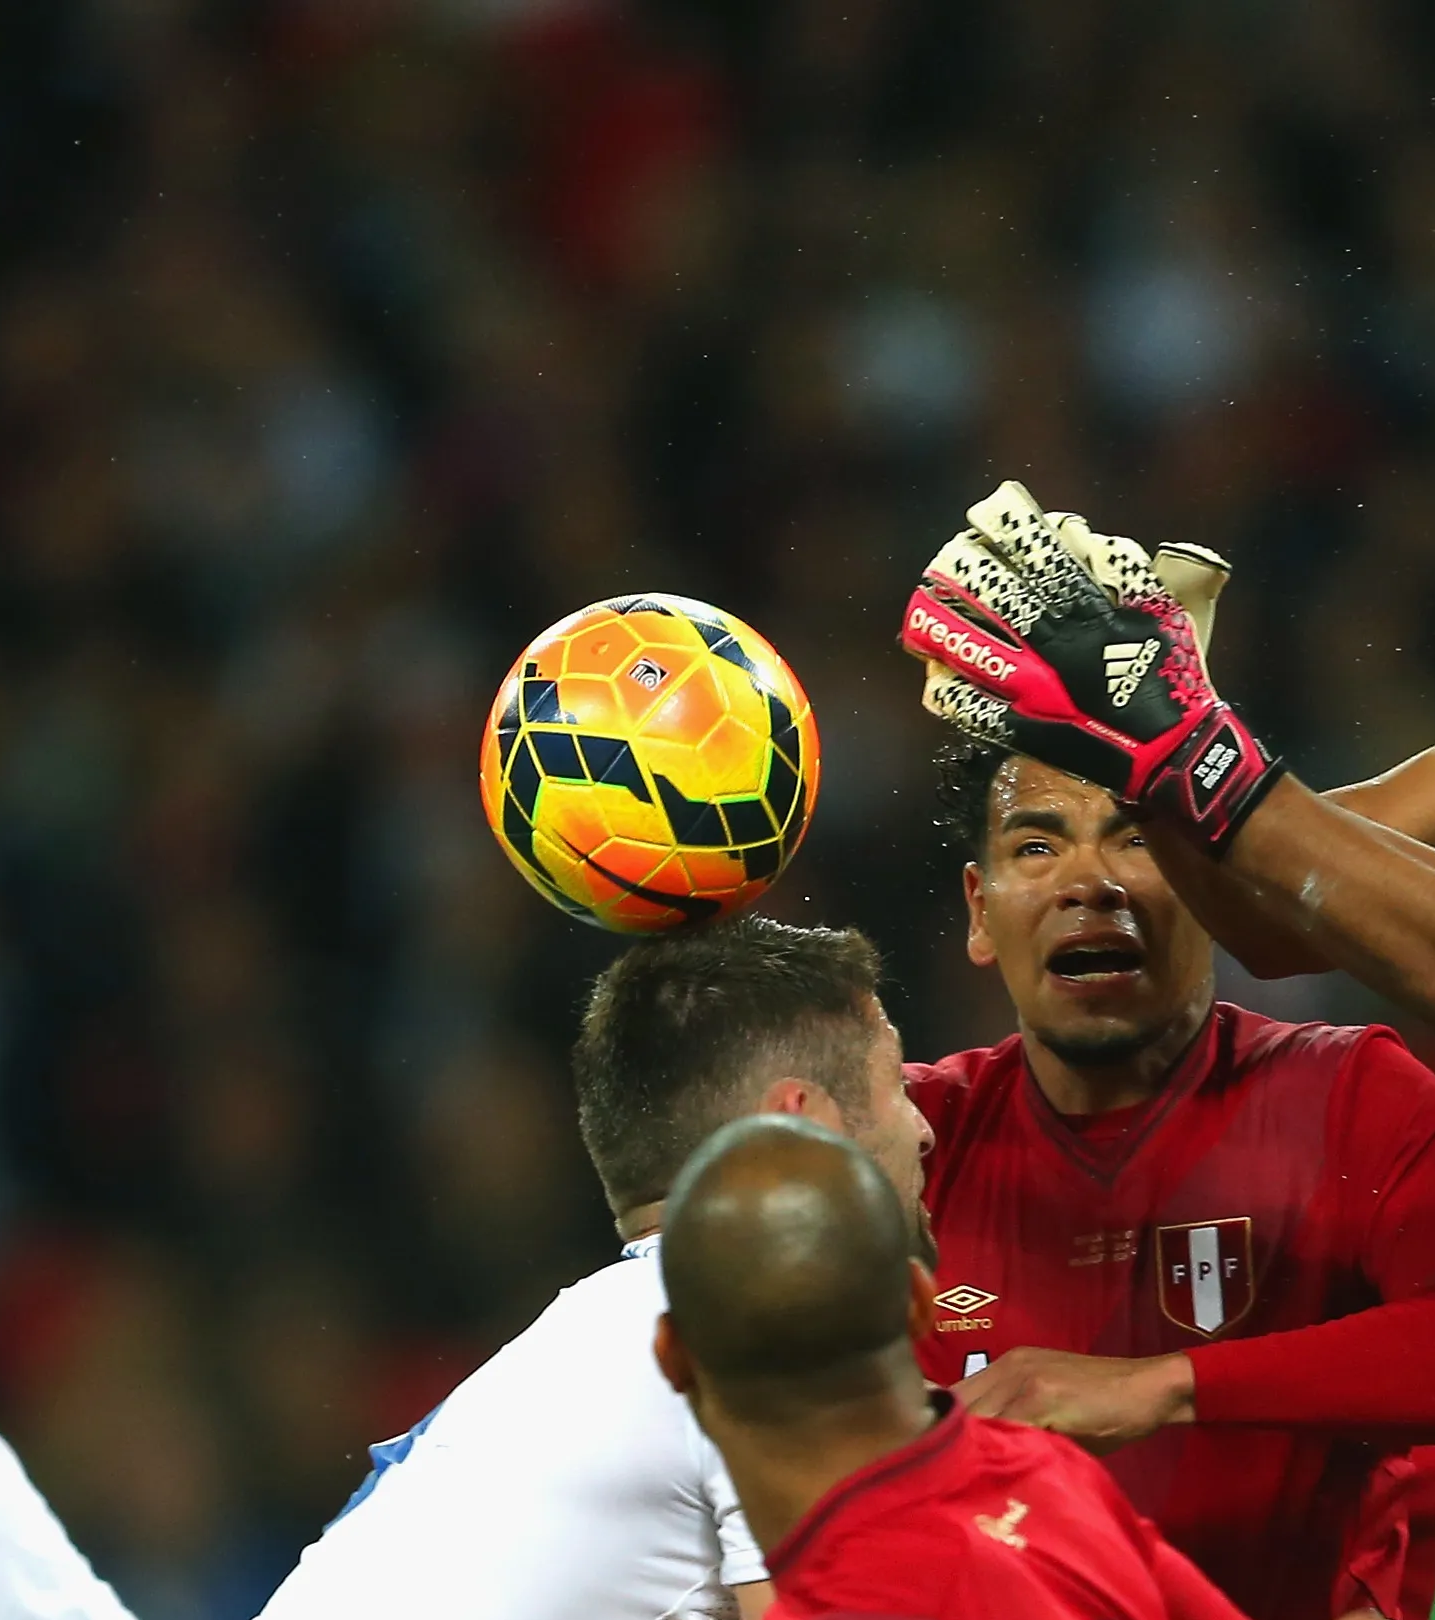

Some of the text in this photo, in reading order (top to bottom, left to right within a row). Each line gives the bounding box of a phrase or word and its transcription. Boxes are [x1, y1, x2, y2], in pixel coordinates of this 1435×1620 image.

[908, 607, 1018, 681] predator
[1112, 637, 1162, 708] adidas
[934, 1316, 994, 1332] umbro
